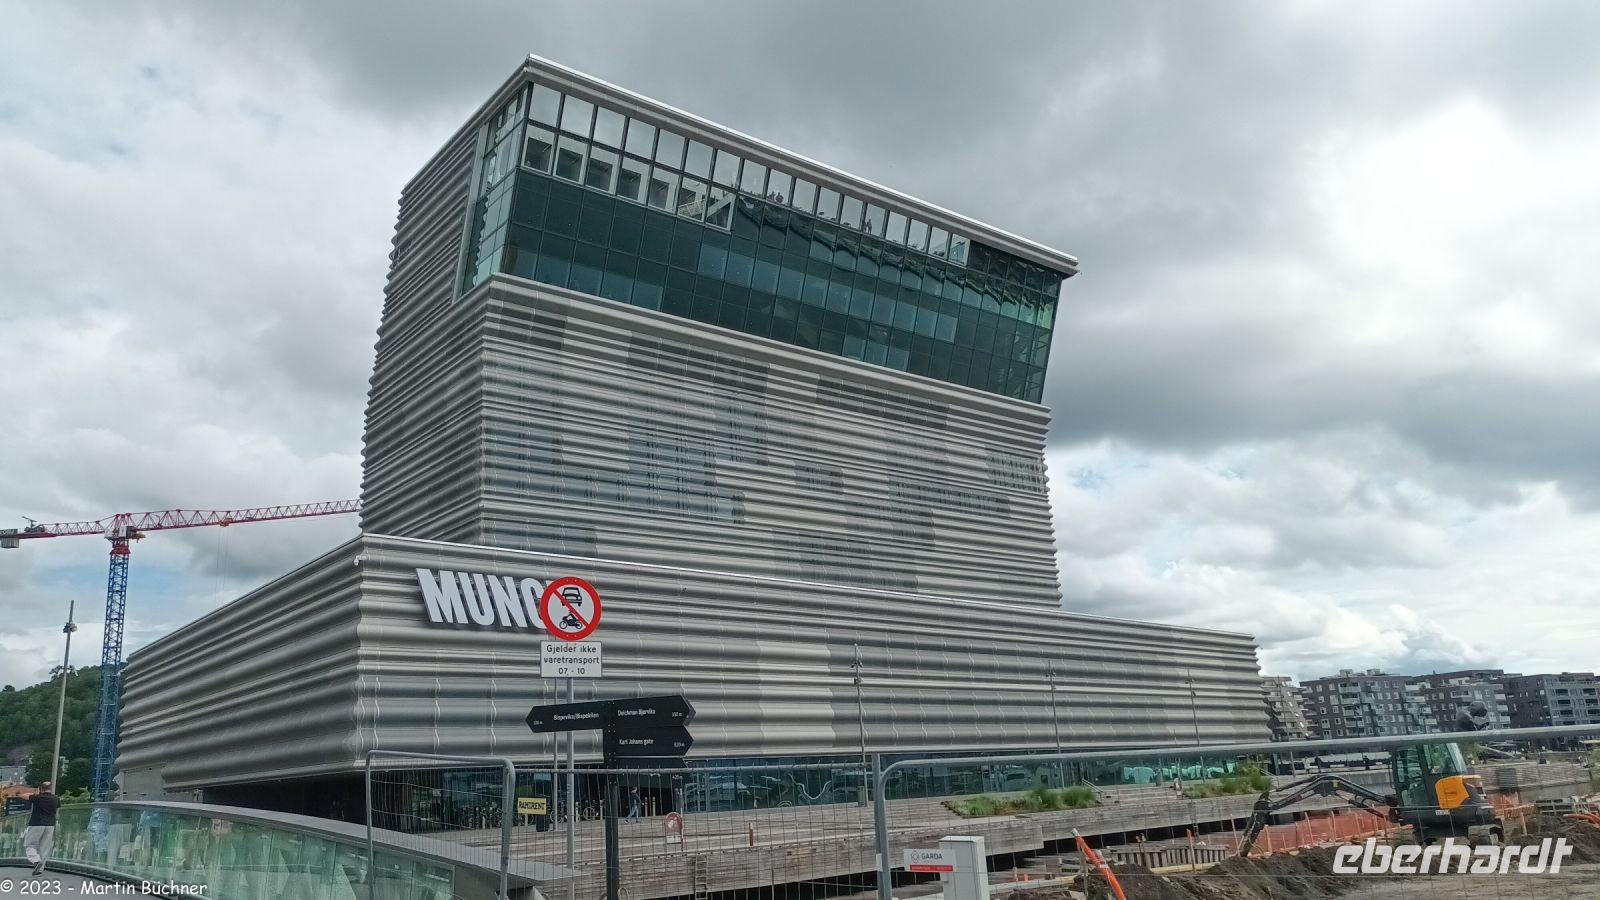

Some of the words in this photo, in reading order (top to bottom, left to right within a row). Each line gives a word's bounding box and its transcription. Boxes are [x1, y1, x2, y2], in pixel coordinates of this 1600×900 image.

[416, 568, 553, 629] MUNC
[547, 644, 577, 654] Gjelder
[581, 645, 597, 653] ikke
[543, 656, 600, 665] varetransport
[558, 667, 568, 675] 07
[577, 667, 586, 675] 10
[921, 852, 943, 860] GARDA
